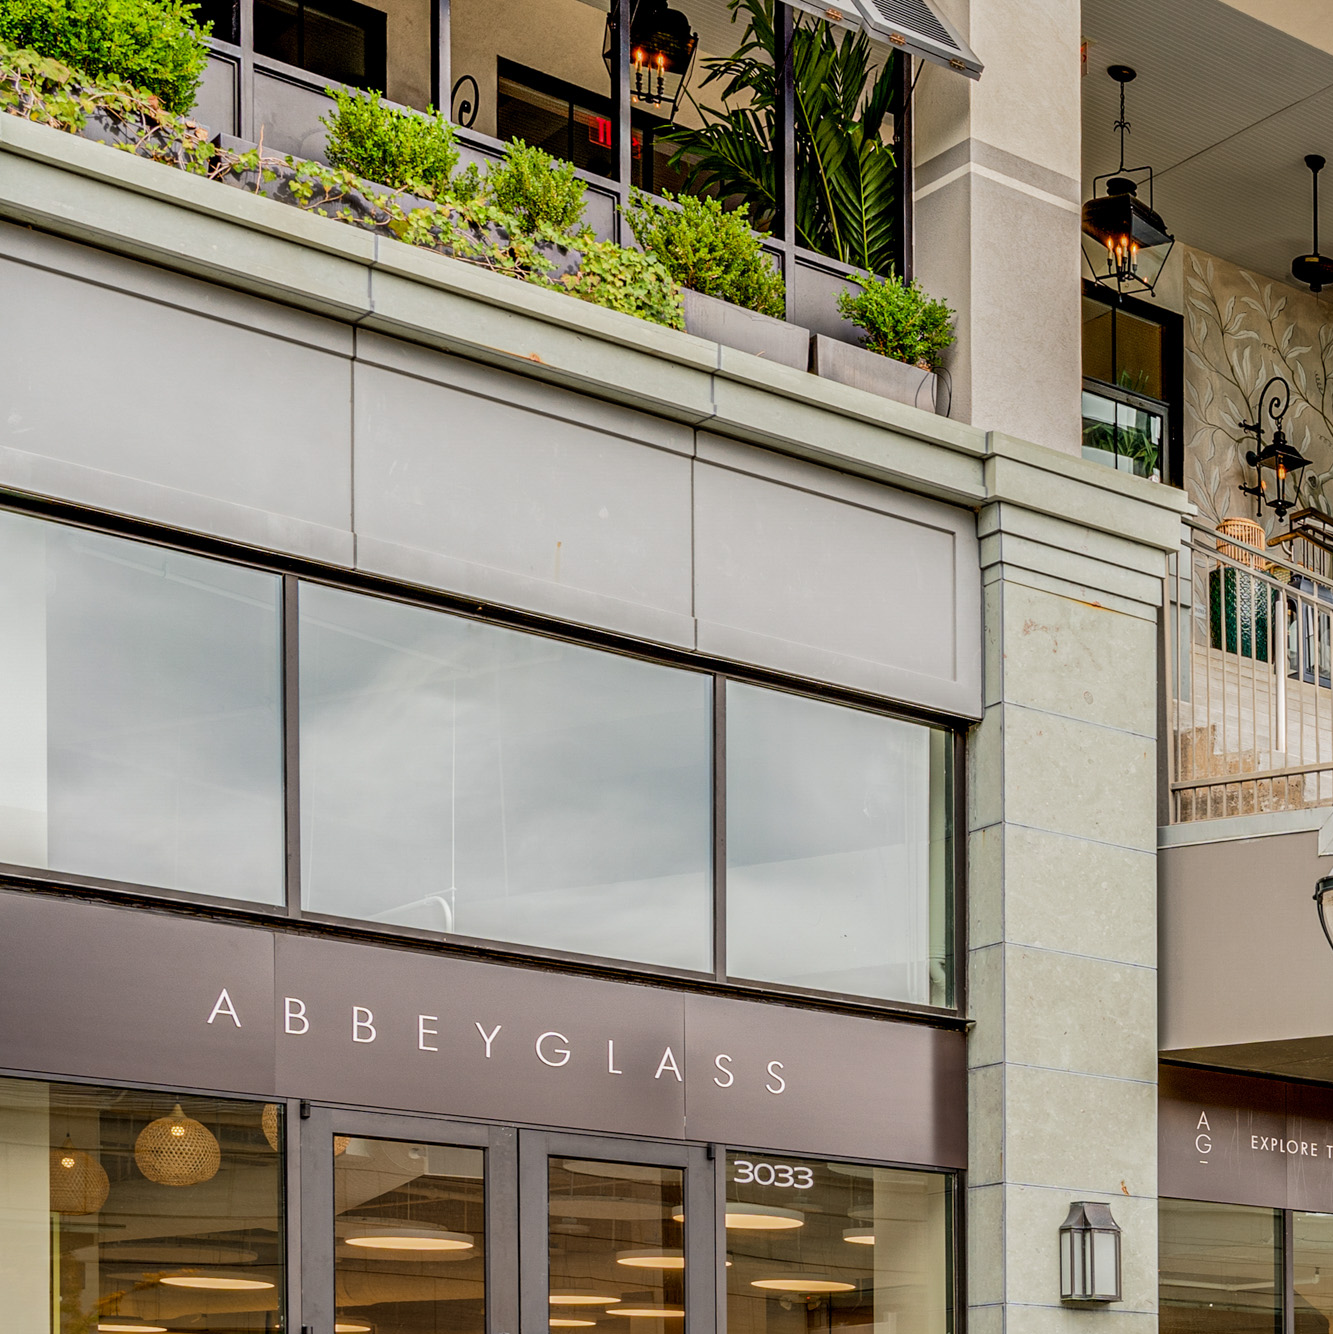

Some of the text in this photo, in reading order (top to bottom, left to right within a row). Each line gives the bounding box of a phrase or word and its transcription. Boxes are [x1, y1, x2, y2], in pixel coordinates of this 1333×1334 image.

[207, 988, 786, 1094] ABBEYGLASS
[1251, 1135, 1318, 1157] EXPLORE
[733, 1160, 814, 1189] 3033
